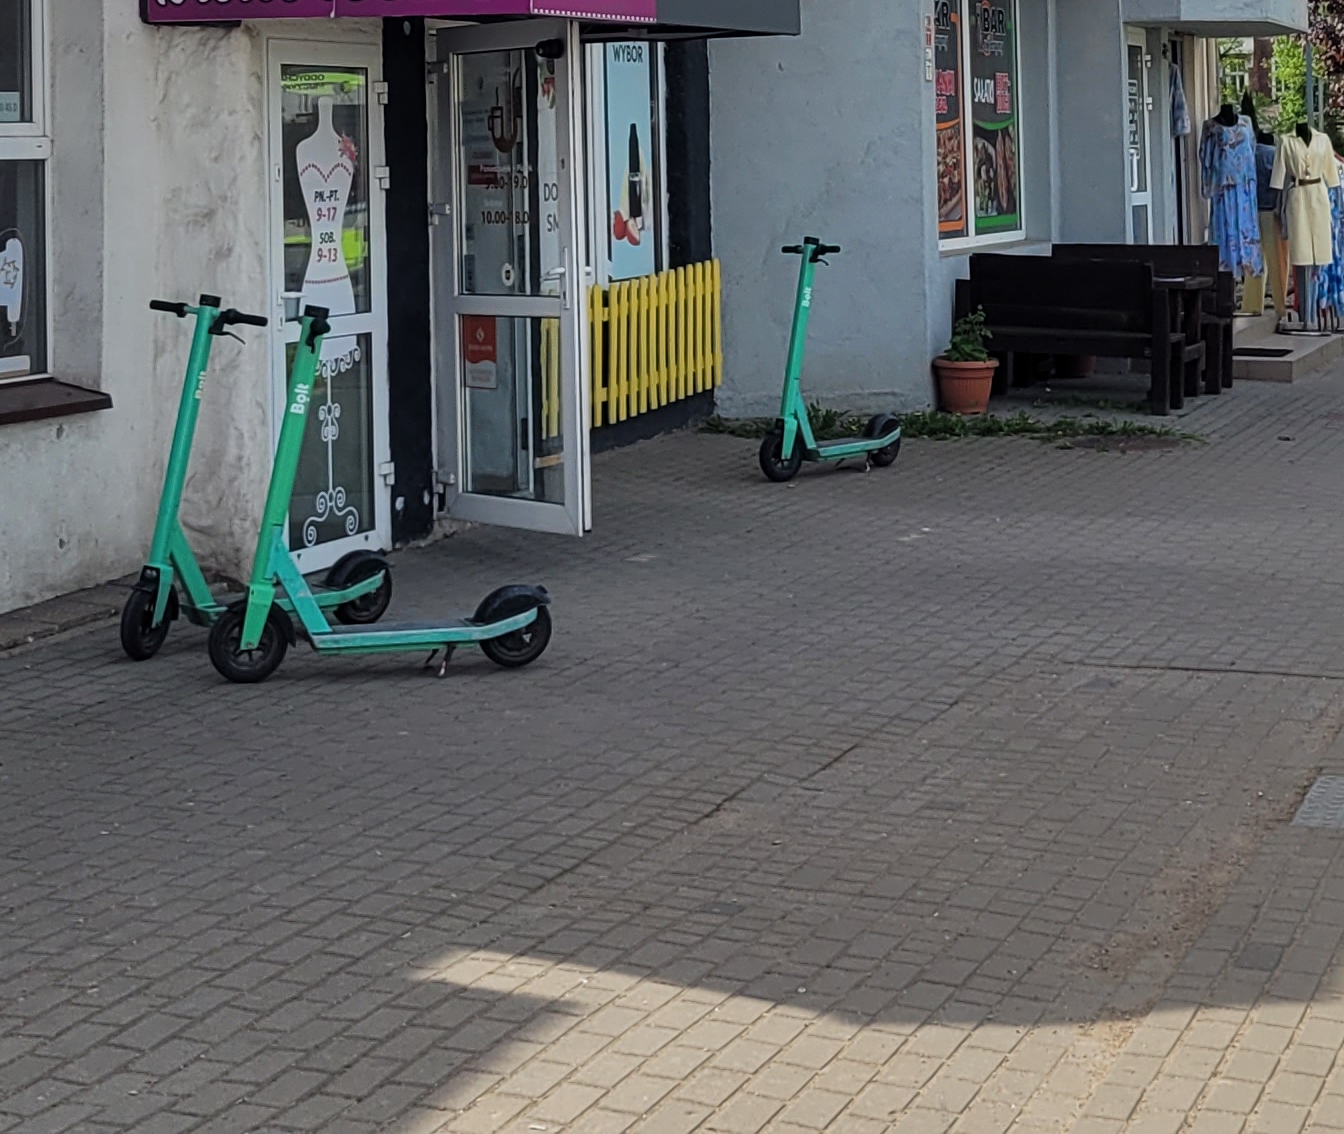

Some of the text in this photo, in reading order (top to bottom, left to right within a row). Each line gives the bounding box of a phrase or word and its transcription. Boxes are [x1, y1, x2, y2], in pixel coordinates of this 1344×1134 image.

[314, 189, 340, 203] PN.-PT.
[316, 207, 337, 222] 9-17
[319, 231, 336, 245] SOB.
[317, 247, 338, 263] 9-13
[290, 383, 311, 415] Bolt
